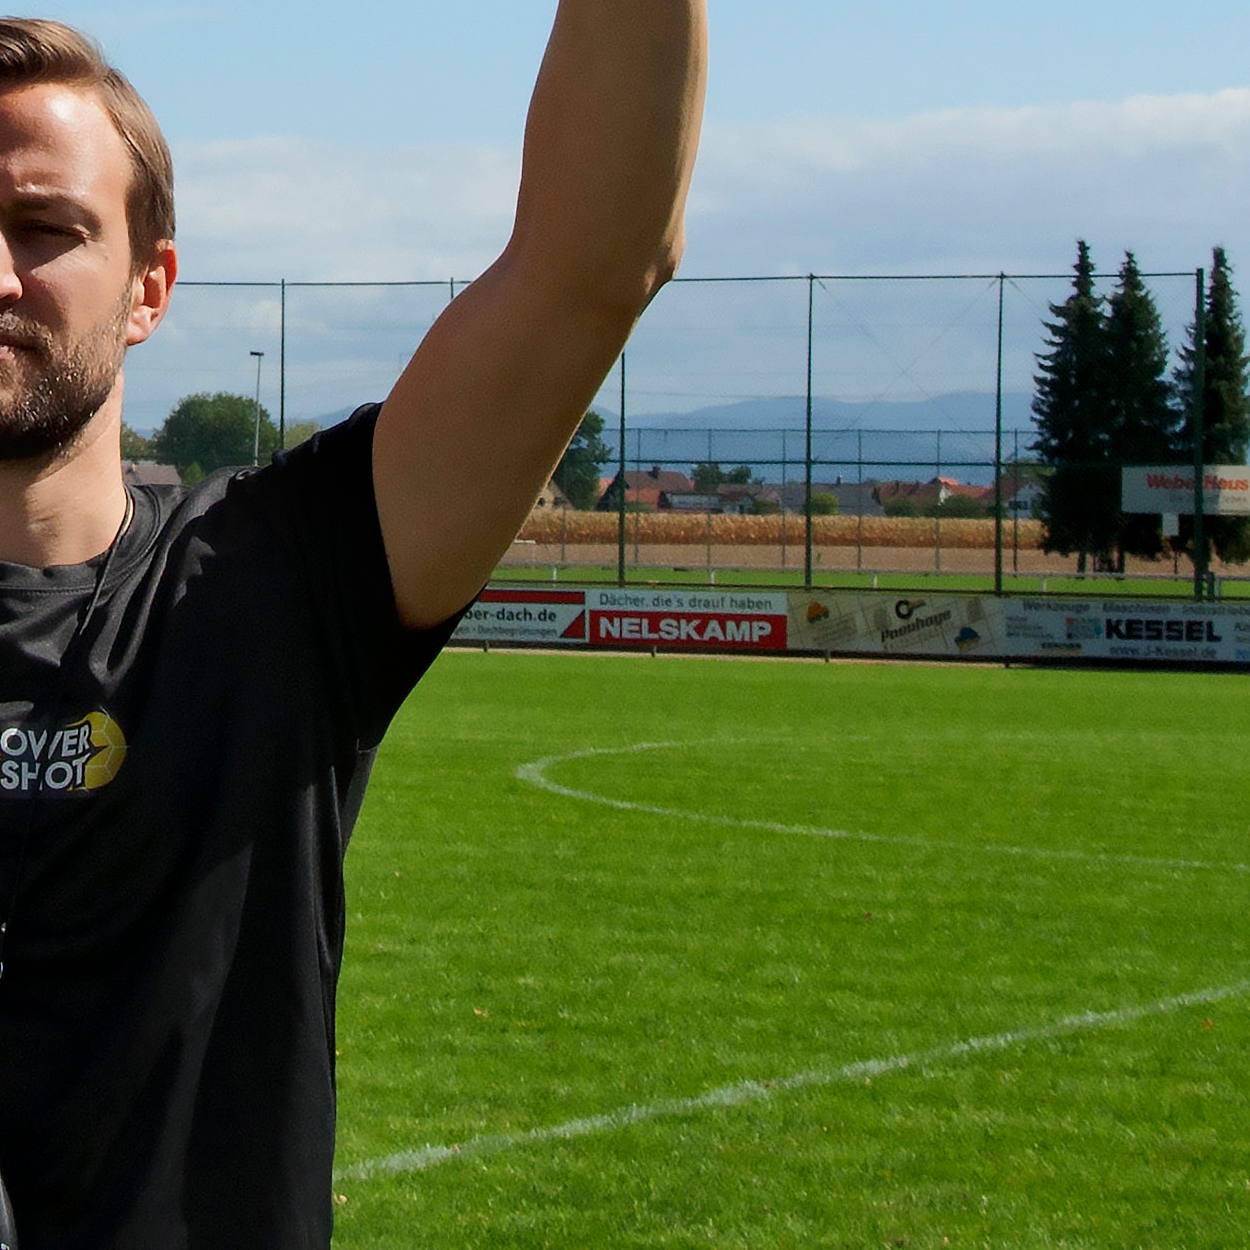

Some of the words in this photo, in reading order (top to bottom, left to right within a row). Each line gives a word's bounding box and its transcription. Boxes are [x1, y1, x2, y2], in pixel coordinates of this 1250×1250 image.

[1146, 474, 1249, 490] WebeHaus
[688, 596, 726, 609] drauf
[730, 596, 772, 611] haben
[599, 616, 772, 642] NELSKAMP
[1105, 618, 1223, 642] KESSEL
[0, 752, 92, 791] SHOT
